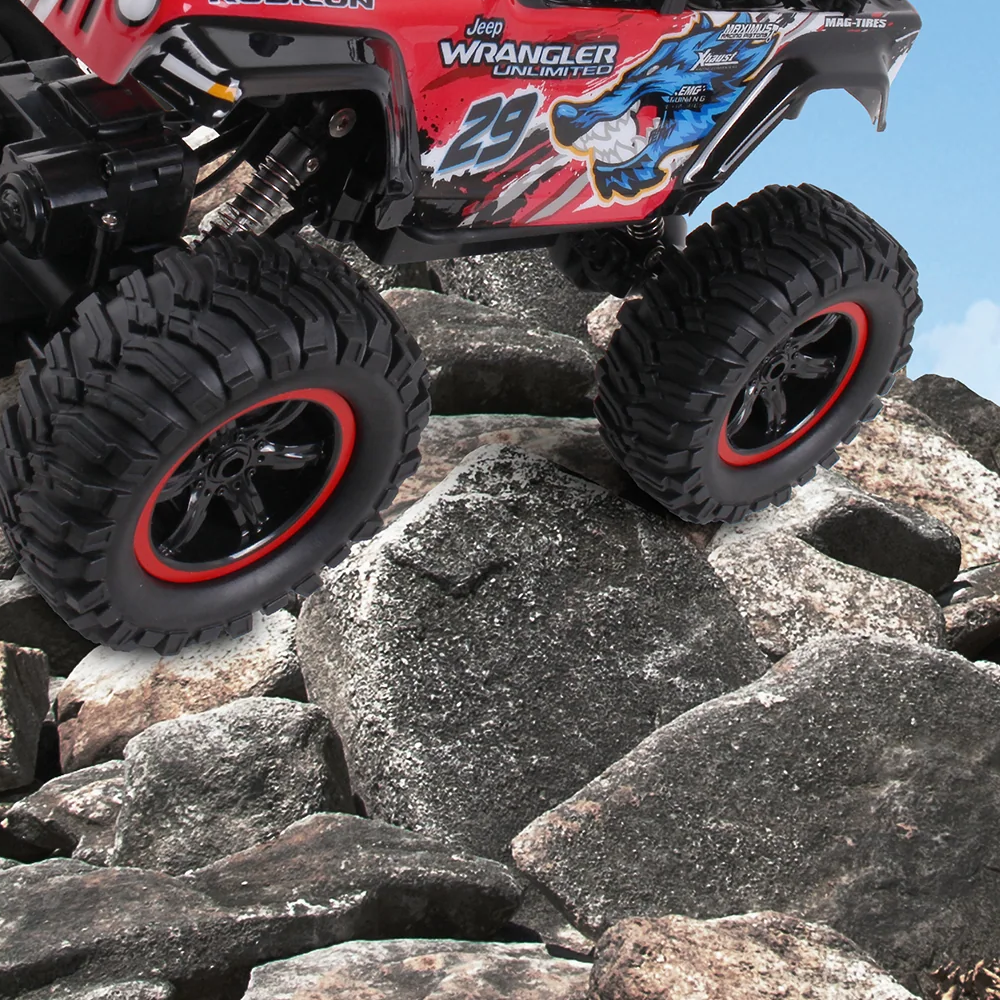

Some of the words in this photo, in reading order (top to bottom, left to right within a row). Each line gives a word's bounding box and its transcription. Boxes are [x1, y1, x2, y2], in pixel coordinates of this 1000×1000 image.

[465, 17, 504, 38] Jeep
[723, 23, 773, 34] MAXIMUS
[825, 17, 887, 28] MAG-TIRES
[439, 40, 618, 65] WRANGLER
[690, 48, 739, 71] Xhaust
[493, 64, 613, 77] UNLIMITED
[435, 91, 540, 174] 29
